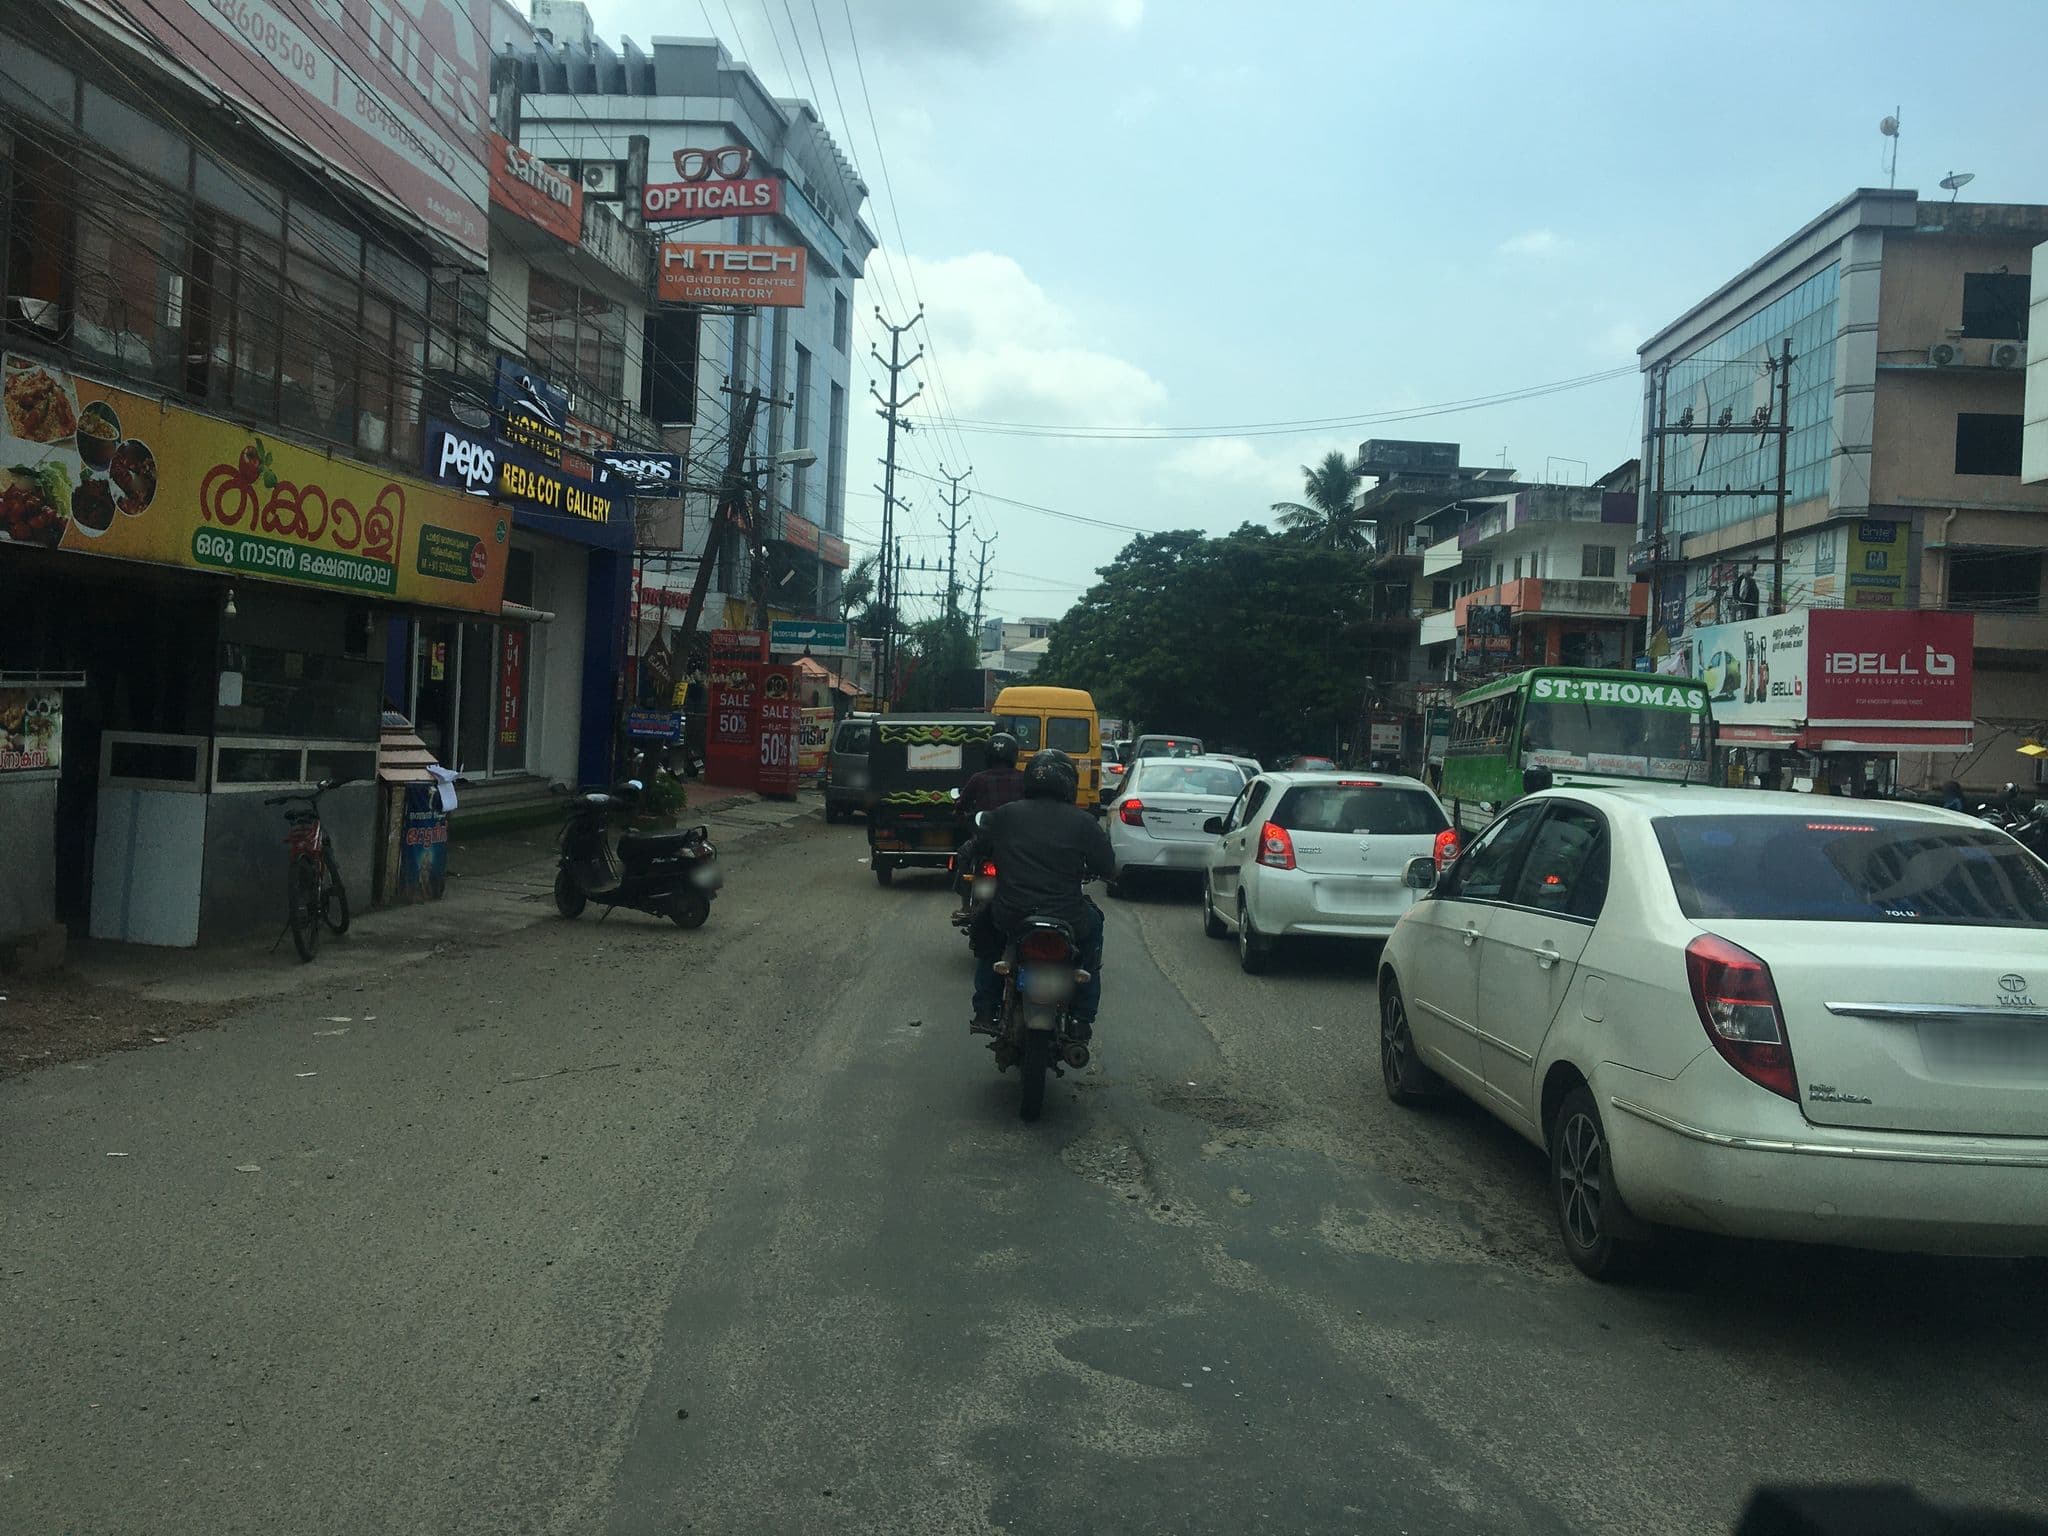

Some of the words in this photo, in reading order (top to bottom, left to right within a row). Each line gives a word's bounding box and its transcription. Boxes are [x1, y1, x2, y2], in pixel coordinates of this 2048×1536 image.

[369, 3, 479, 134] TILES
[505, 145, 573, 208] Saffron
[645, 184, 771, 211] OPTICALS
[664, 248, 695, 269] HI
[701, 249, 797, 272] TECH
[665, 274, 740, 286] DIAGNOSTIC
[748, 277, 797, 288] CENTRE
[686, 286, 774, 299] LABORATORY
[440, 432, 495, 487] peps
[566, 490, 611, 524] GALLERY
[196, 534, 234, 564] ഒരു
[240, 541, 295, 569] നാടൻ
[299, 552, 390, 587] ഭക്ഷണശാല
[1825, 652, 1919, 674] iBELL
[1825, 678, 1850, 686] HIGH
[1856, 678, 1904, 686] PRESSURE
[720, 693, 750, 707] SALE
[762, 704, 790, 719] SALE
[720, 713, 748, 733] 50%
[501, 731, 517, 743] FREE
[761, 732, 788, 765] 50%
[1996, 994, 2036, 1005] TATA
